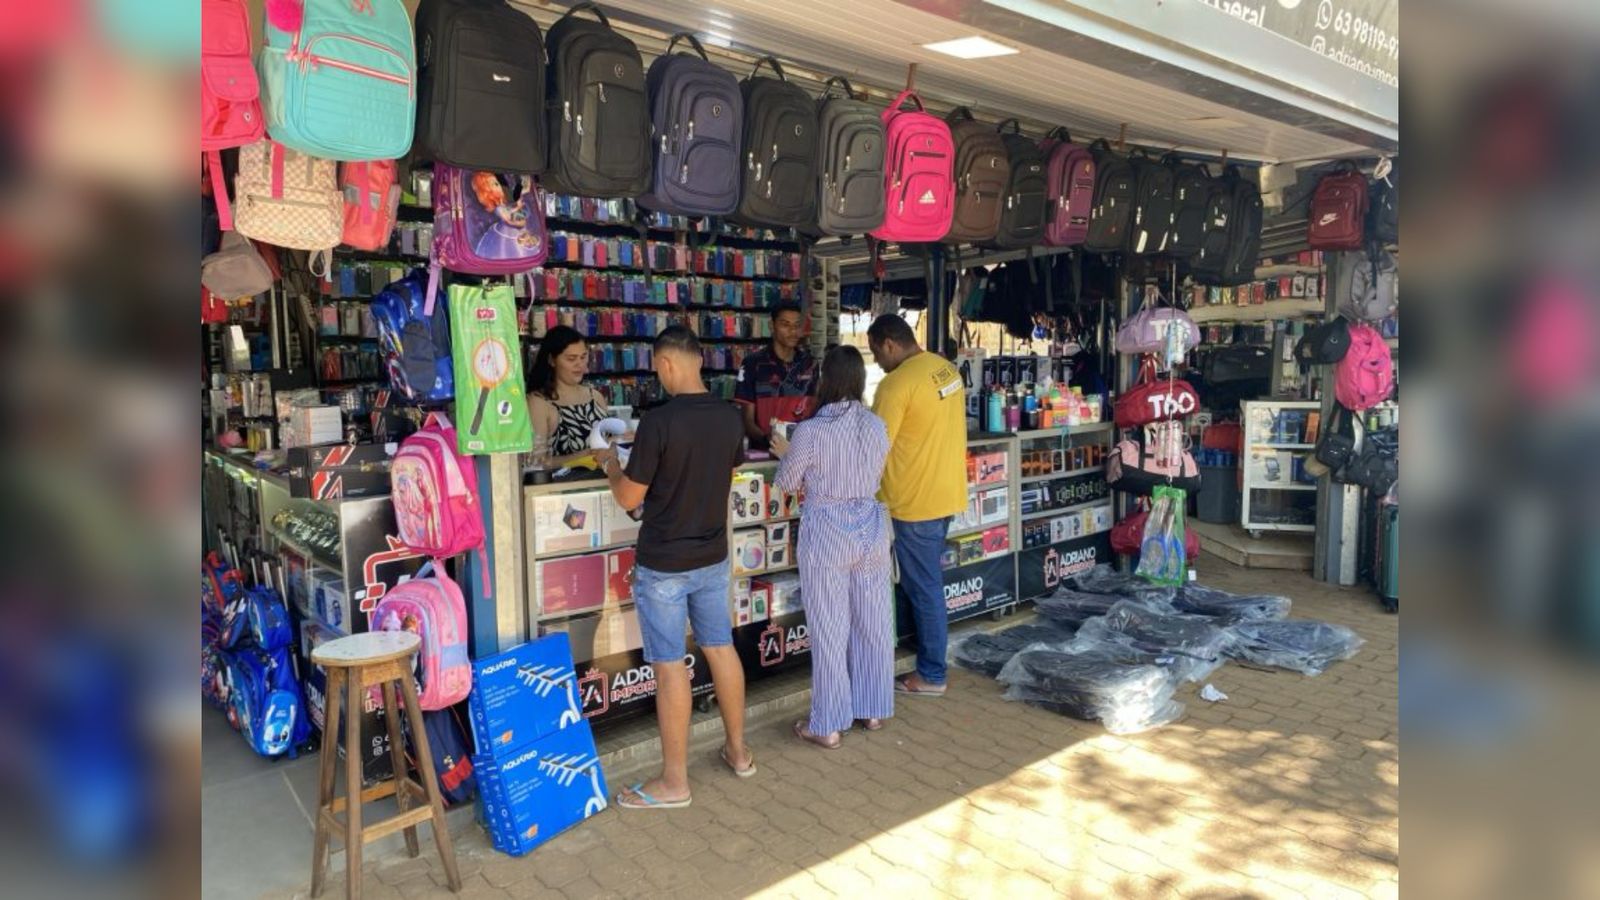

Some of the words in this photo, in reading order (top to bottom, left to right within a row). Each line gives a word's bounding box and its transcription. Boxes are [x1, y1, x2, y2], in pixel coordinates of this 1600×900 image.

[1334, 8, 1352, 36] 63
[1060, 546, 1096, 566] ADRIANO
[943, 576, 984, 600] DRIANO
